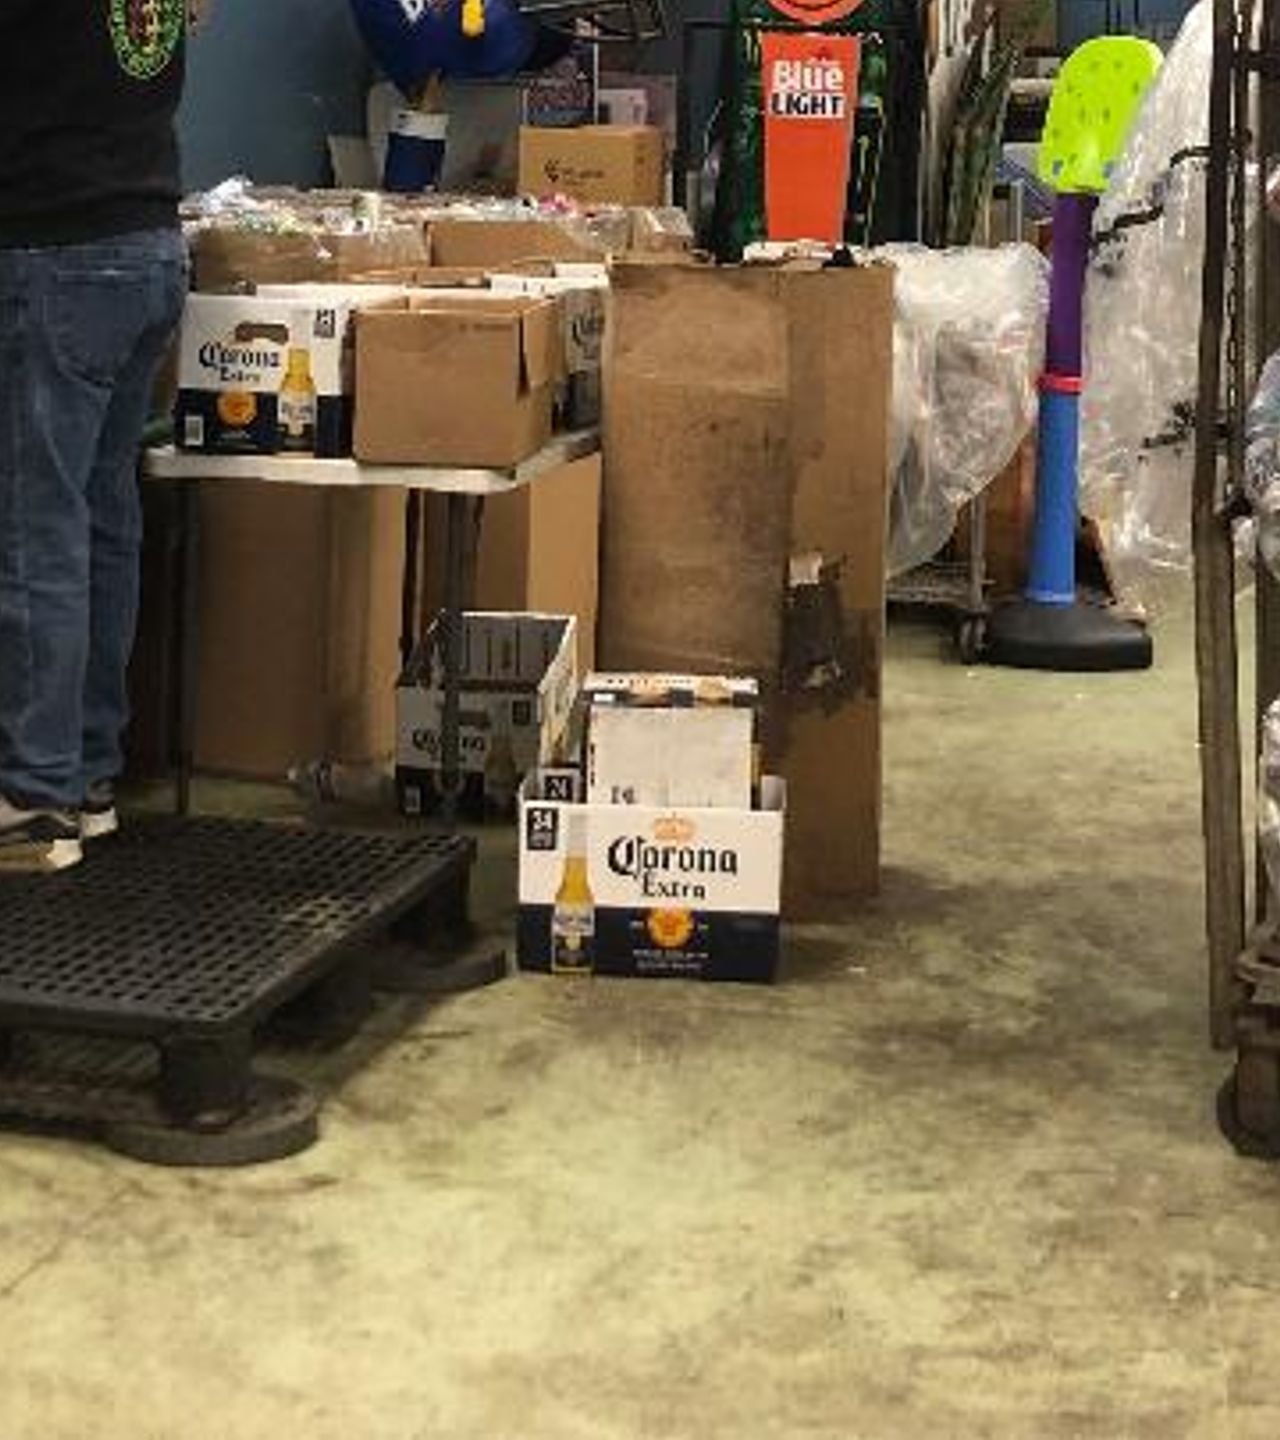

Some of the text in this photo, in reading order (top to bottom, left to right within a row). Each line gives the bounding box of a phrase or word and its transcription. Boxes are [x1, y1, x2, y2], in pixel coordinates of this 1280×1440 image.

[773, 60, 845, 91] Blue
[770, 93, 844, 115] LIGHT
[198, 341, 281, 370] Corona
[608, 835, 738, 880] Corona
[641, 871, 705, 900] Extra
